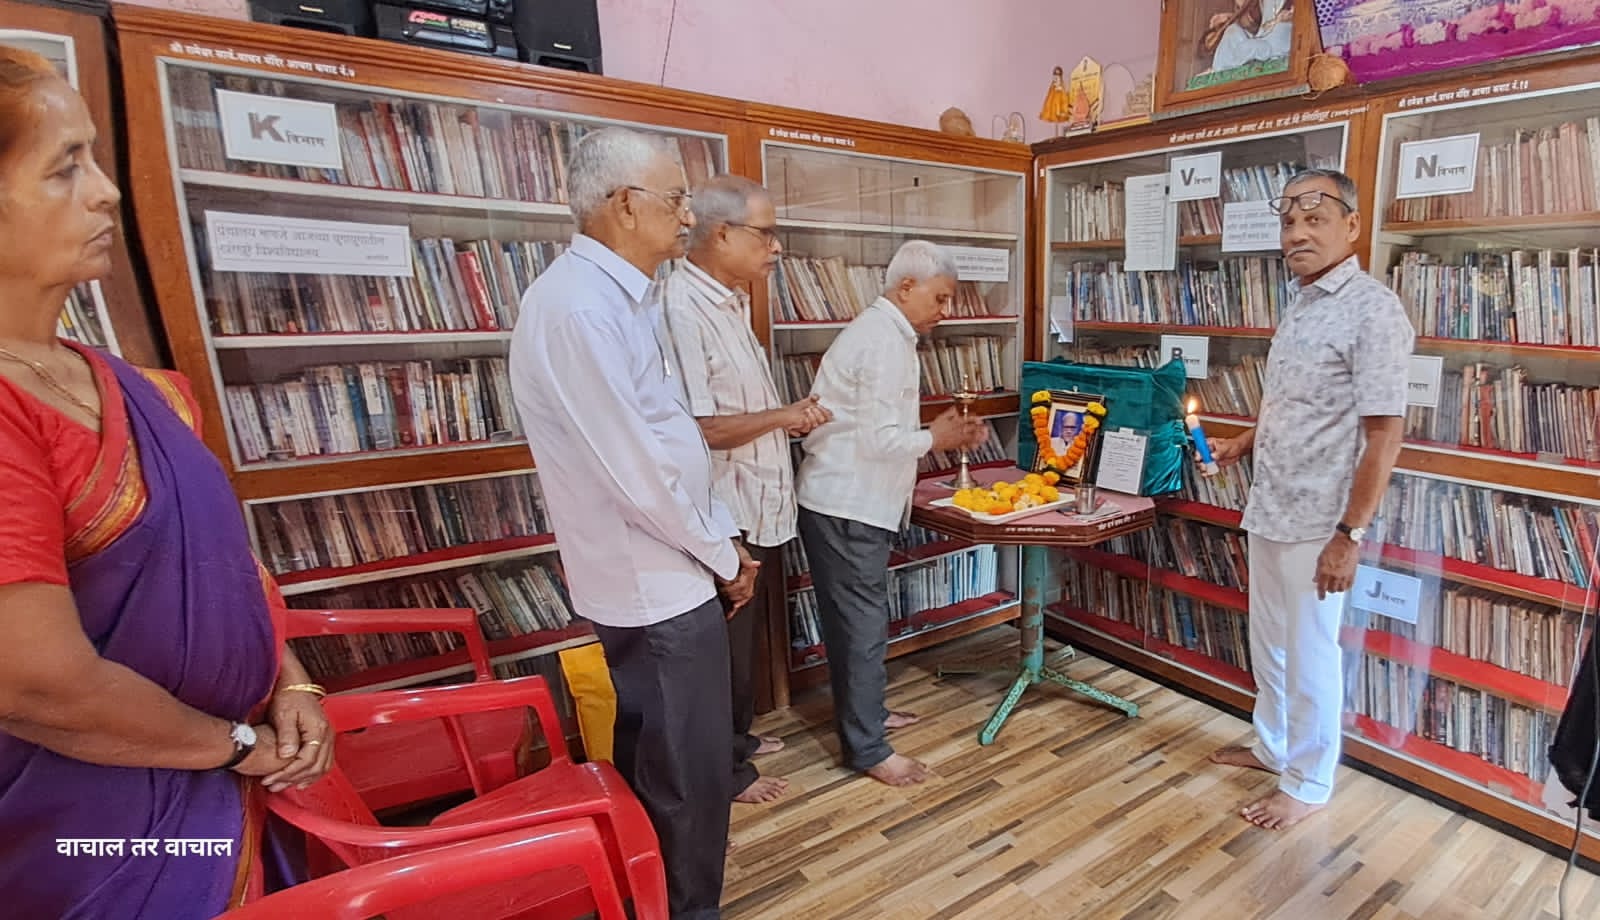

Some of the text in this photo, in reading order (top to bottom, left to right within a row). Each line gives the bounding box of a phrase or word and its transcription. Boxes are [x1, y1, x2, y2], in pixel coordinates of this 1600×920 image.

[248, 111, 325, 147] K विभाग
[1180, 167, 1195, 187] V
[1415, 154, 1466, 179] N विभाग
[1365, 580, 1382, 599] J
